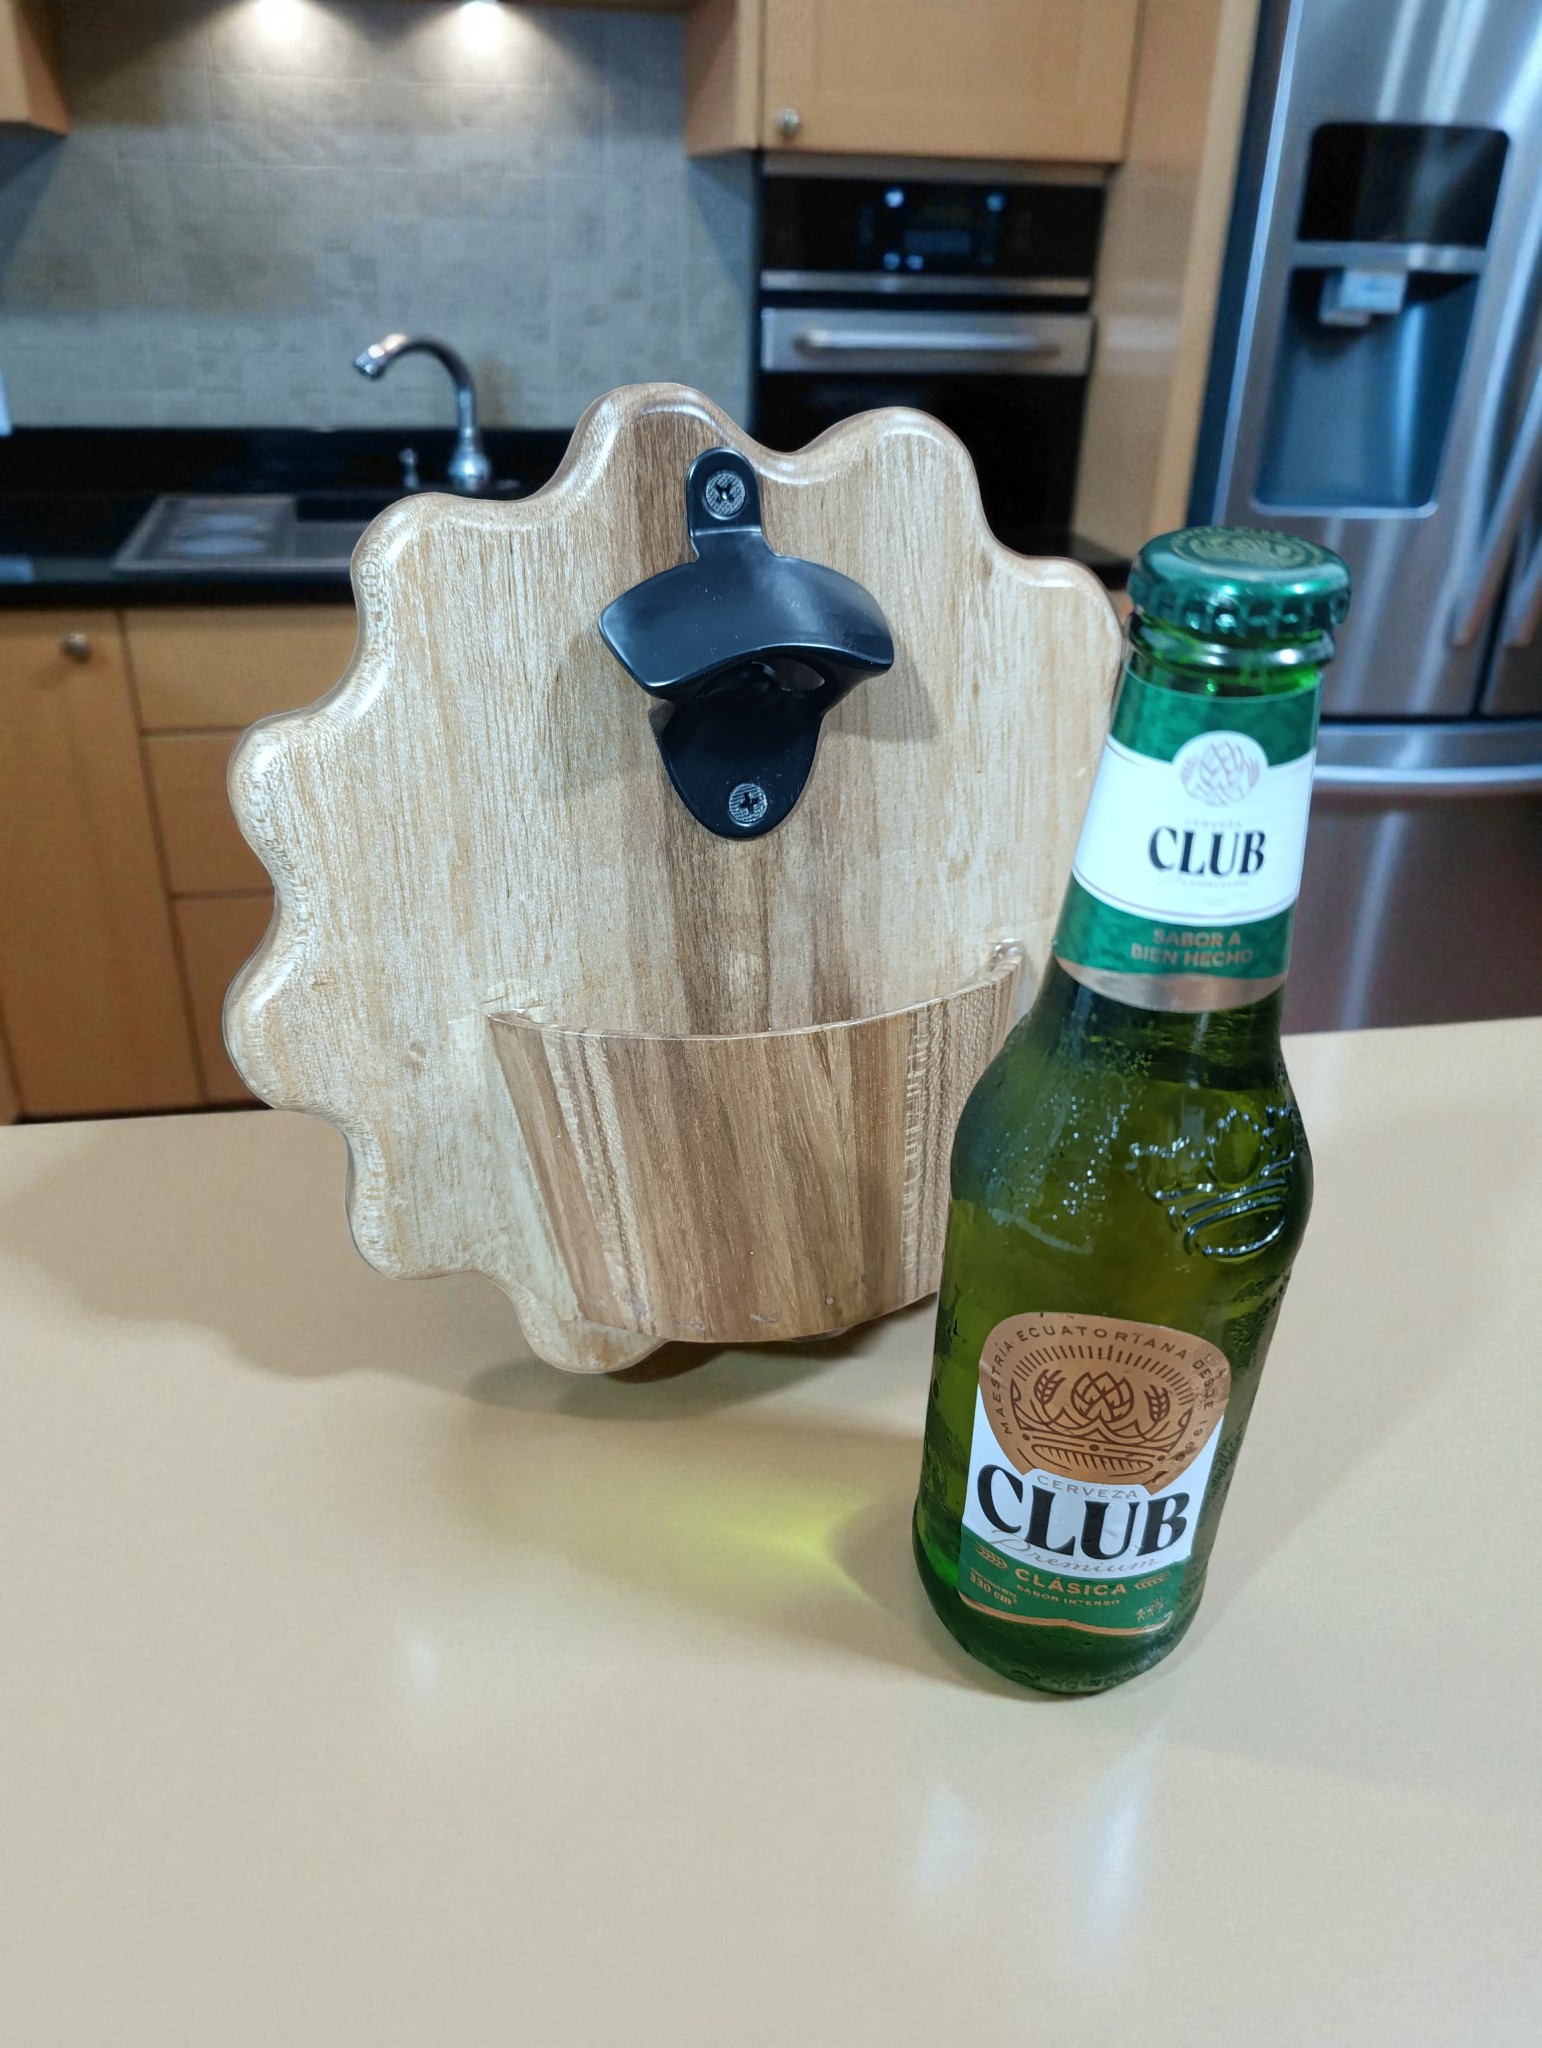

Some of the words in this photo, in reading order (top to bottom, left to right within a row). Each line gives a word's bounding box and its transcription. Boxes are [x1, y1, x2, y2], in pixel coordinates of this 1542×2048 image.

[1148, 825, 1266, 877] CLUB
[1153, 928, 1224, 948] SABOR
[1228, 930, 1241, 946] A
[1130, 942, 1178, 965] BIEN
[1184, 948, 1254, 968] HECHO
[1192, 1359, 1215, 1411] DESDE
[1037, 1475, 1138, 1498] CERVEZA
[977, 1464, 1190, 1560] CLUB
[988, 1529, 1162, 1573] Premium
[1014, 1568, 1127, 1596] CLÁSICA
[1016, 1584, 1059, 1602] SABOR
[1063, 1597, 1120, 1607] INTENSO
